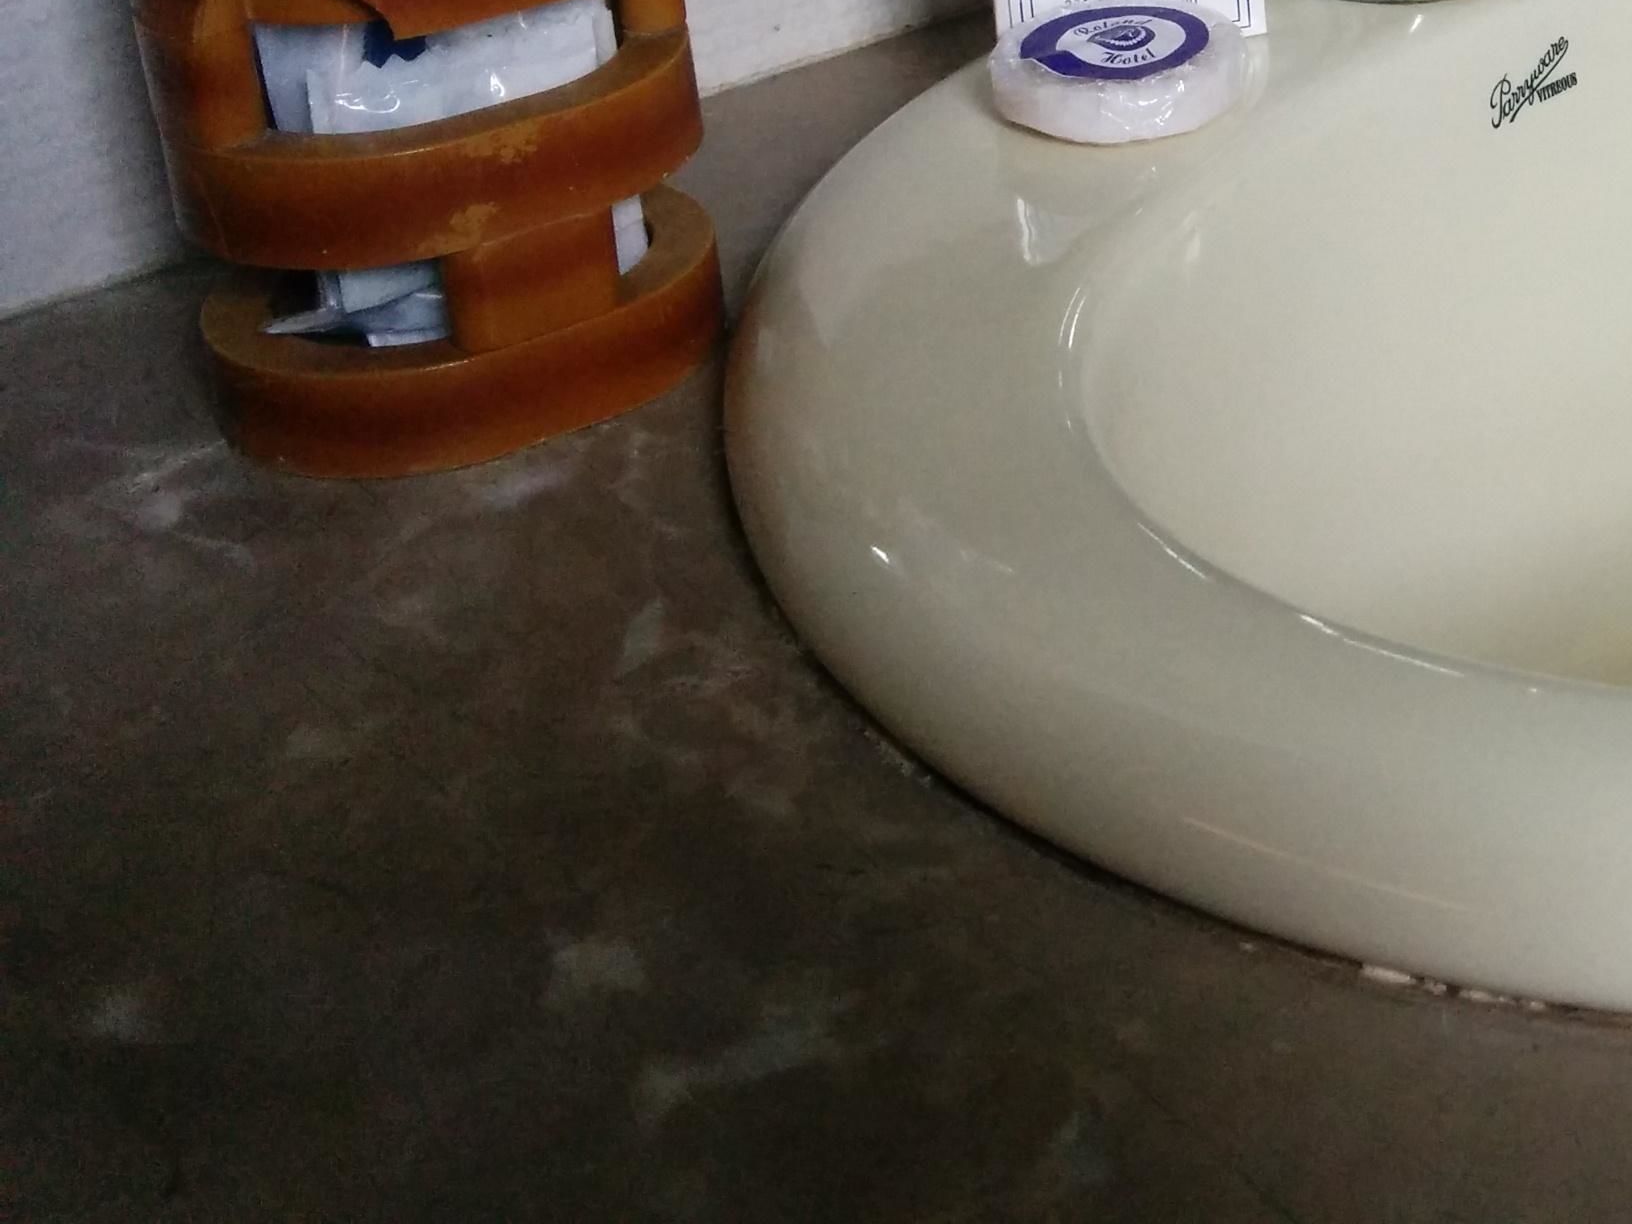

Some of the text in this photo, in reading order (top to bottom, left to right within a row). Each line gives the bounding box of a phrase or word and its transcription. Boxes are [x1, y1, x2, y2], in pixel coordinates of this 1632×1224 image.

[1101, 47, 1156, 66] Hotel
[1489, 35, 1569, 129] Parryware
[1535, 71, 1578, 103] VITREOUS
